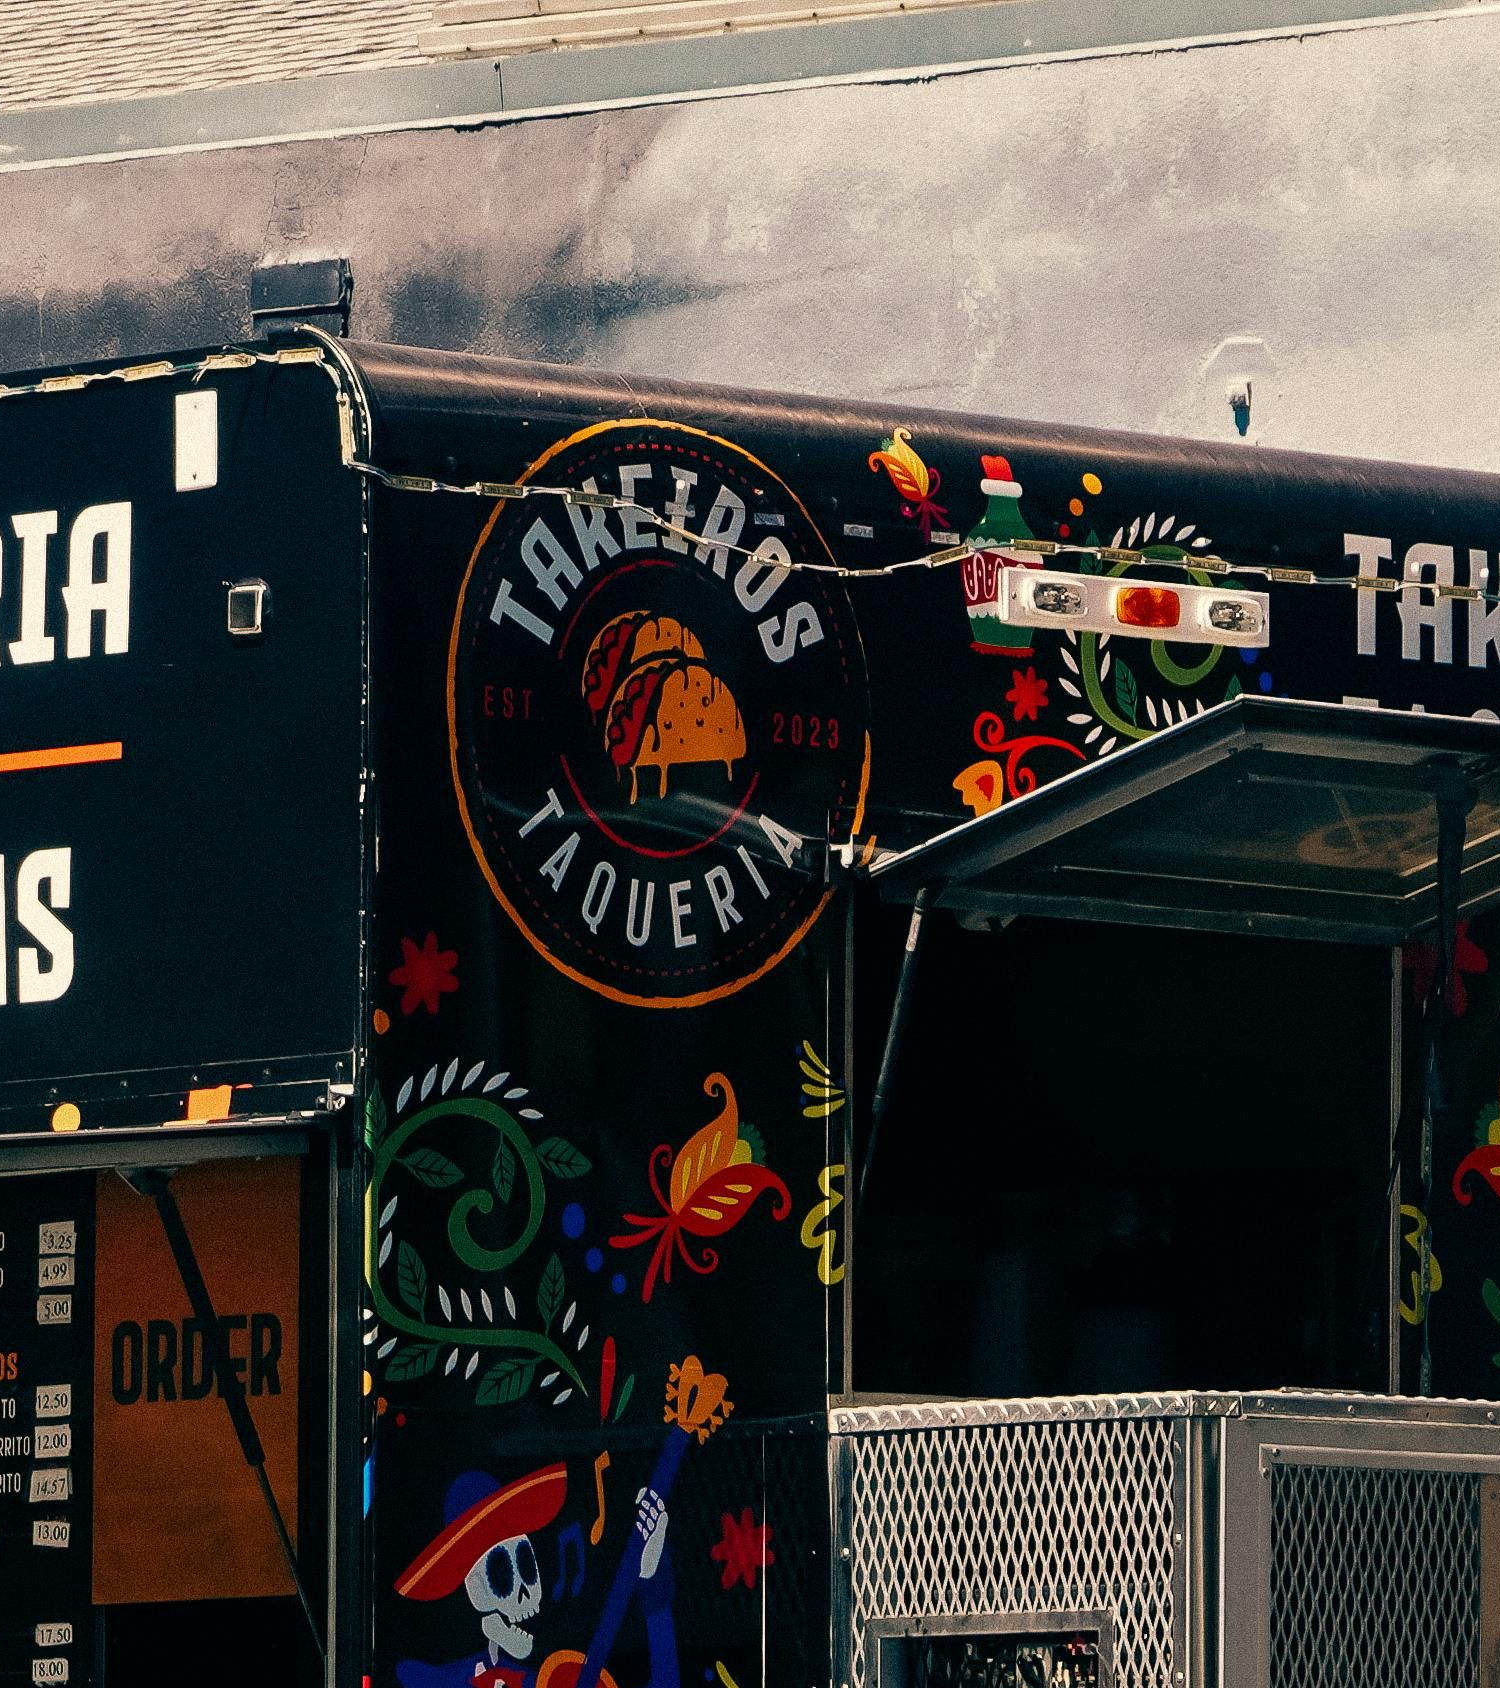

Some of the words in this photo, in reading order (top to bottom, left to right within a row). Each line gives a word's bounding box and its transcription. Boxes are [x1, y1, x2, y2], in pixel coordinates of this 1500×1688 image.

[489, 463, 825, 664] TAKEIROS
[773, 712, 839, 749] 2023
[518, 787, 803, 949] TAQUERIA
[43, 1263, 67, 1280] 4.99
[44, 1300, 68, 1318] 5.00
[111, 1312, 282, 1406] ORDER
[37, 1392, 67, 1409] 12.50
[37, 1433, 67, 1449] 12.00
[37, 1525, 67, 1541] 13.00
[40, 1627, 70, 1643] 17.50
[33, 1662, 63, 1678] 18.00
